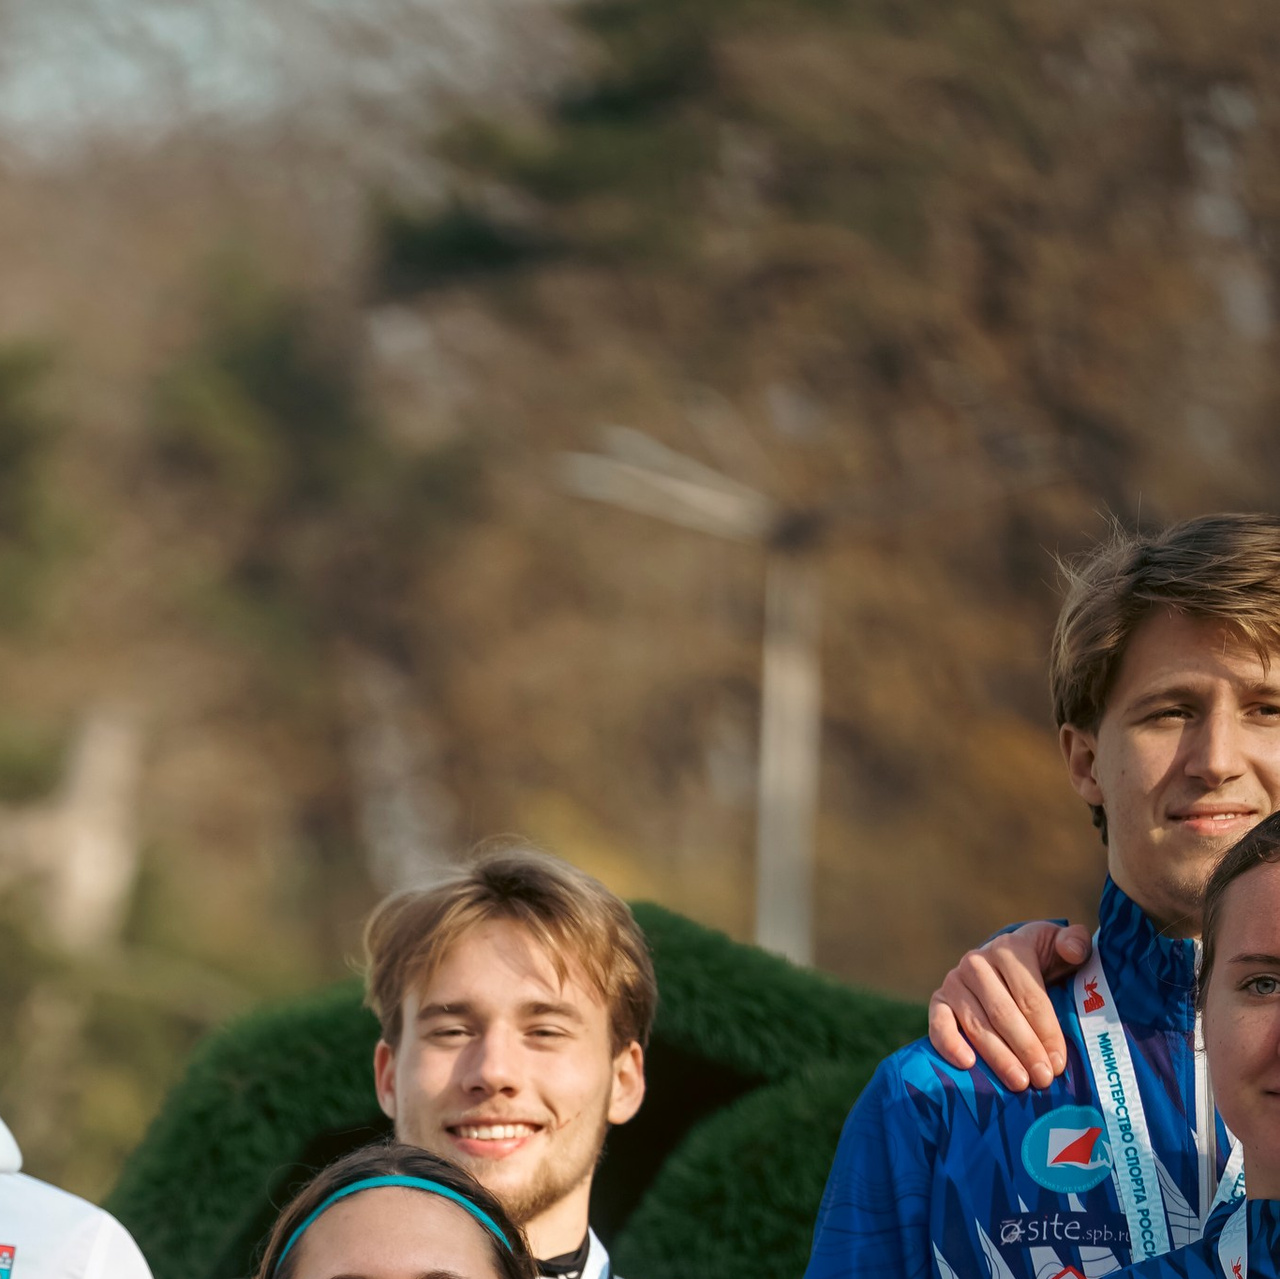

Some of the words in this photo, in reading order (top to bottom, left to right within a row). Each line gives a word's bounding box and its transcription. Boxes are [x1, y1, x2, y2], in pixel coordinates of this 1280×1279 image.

[1097, 1032, 1134, 1144] МИНИСТЕРСТВО
[1124, 1146, 1147, 1205] СПОРТА
[1138, 1208, 1156, 1260] РОССИ
